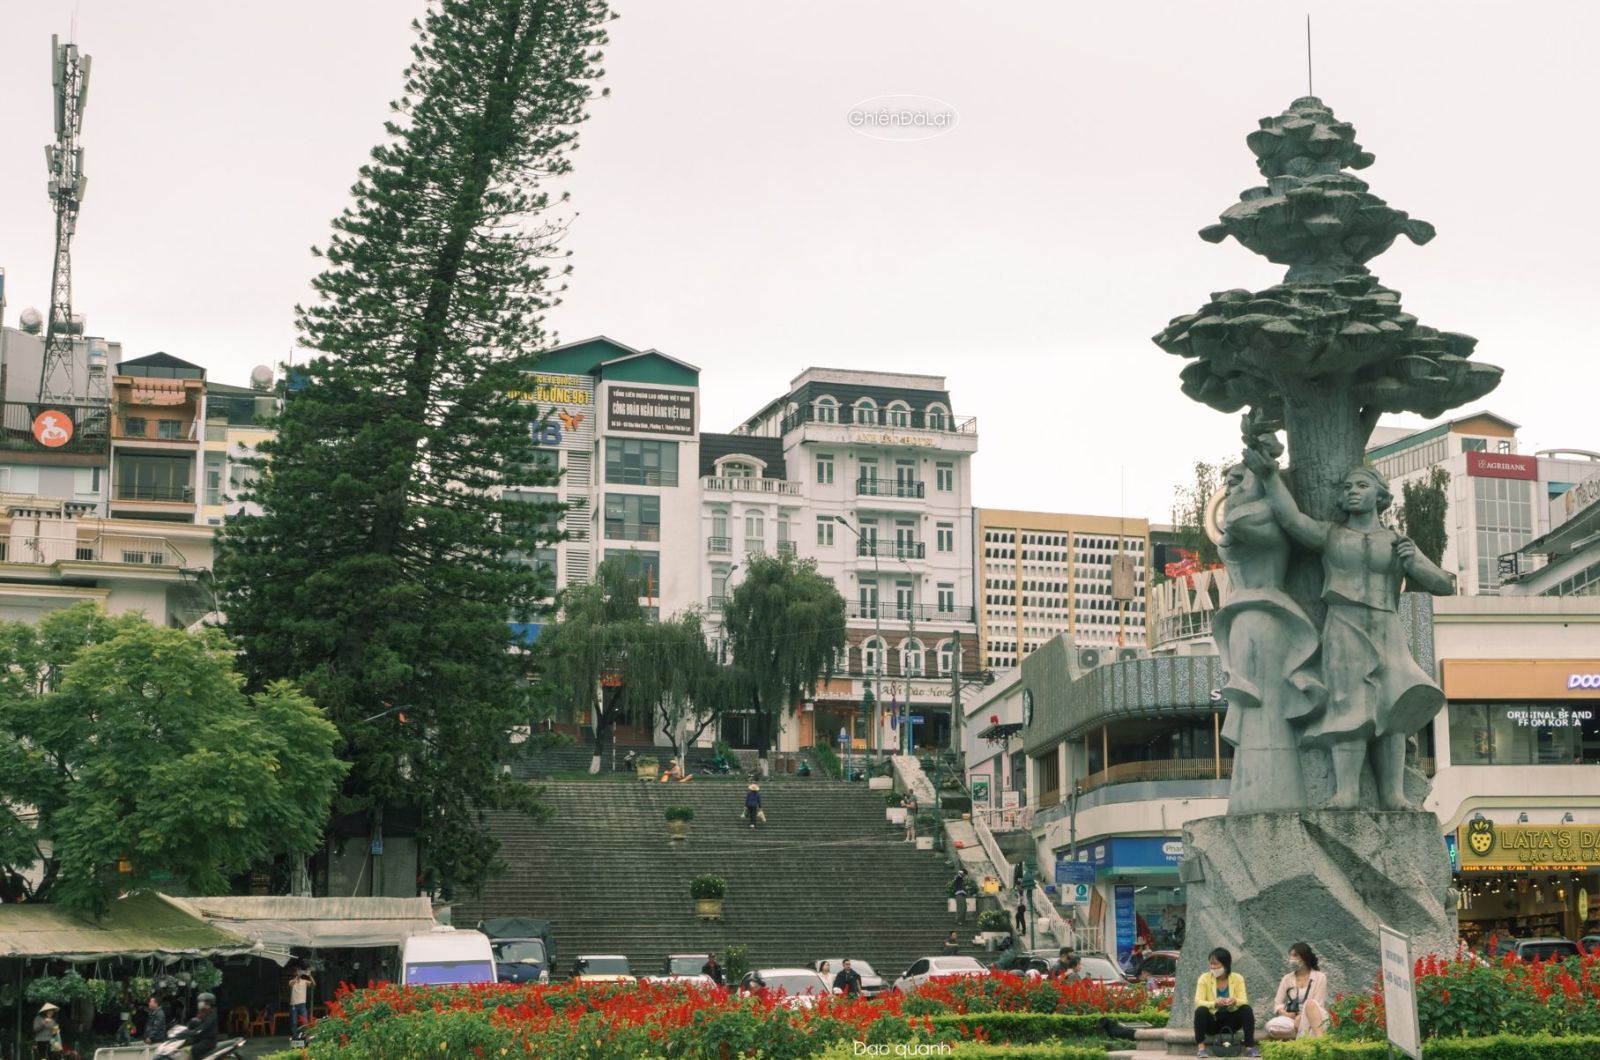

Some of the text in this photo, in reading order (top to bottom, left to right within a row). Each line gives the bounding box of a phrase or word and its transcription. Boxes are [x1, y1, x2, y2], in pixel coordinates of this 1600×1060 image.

[1486, 462, 1527, 472] AGRIBANK
[1548, 719, 1582, 727] KORA
[1501, 830, 1572, 849] LATA'S
